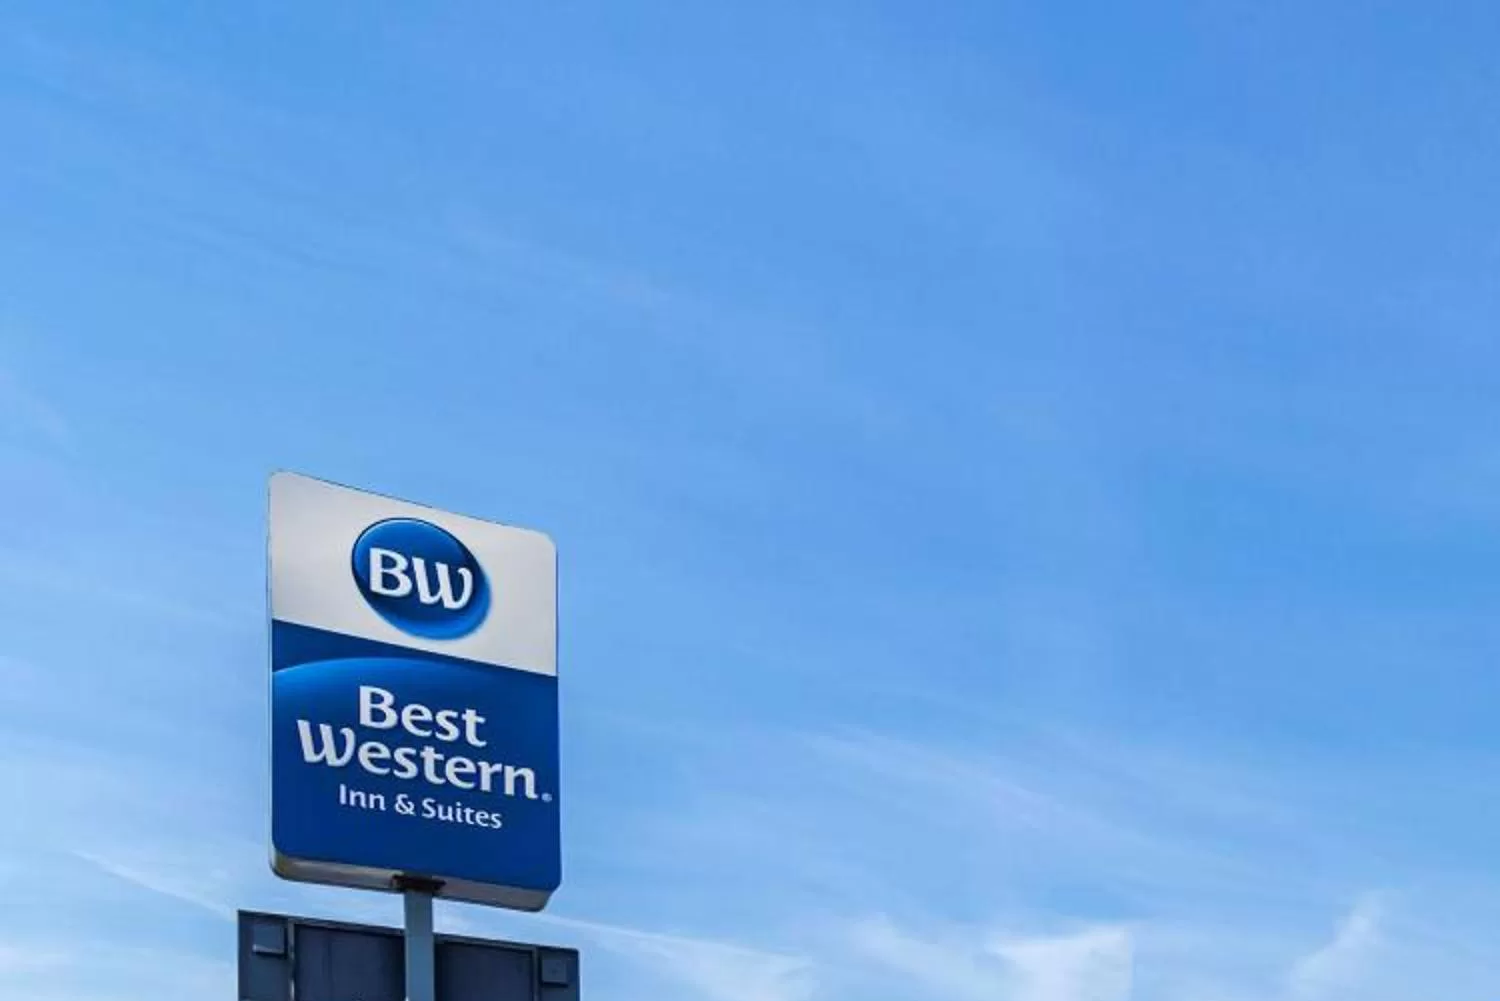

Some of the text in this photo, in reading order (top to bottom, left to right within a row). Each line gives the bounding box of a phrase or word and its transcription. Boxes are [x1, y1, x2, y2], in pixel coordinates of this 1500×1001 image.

[369, 547, 474, 611] BW
[359, 685, 487, 748] Best
[339, 784, 503, 829] Inn & Suites
